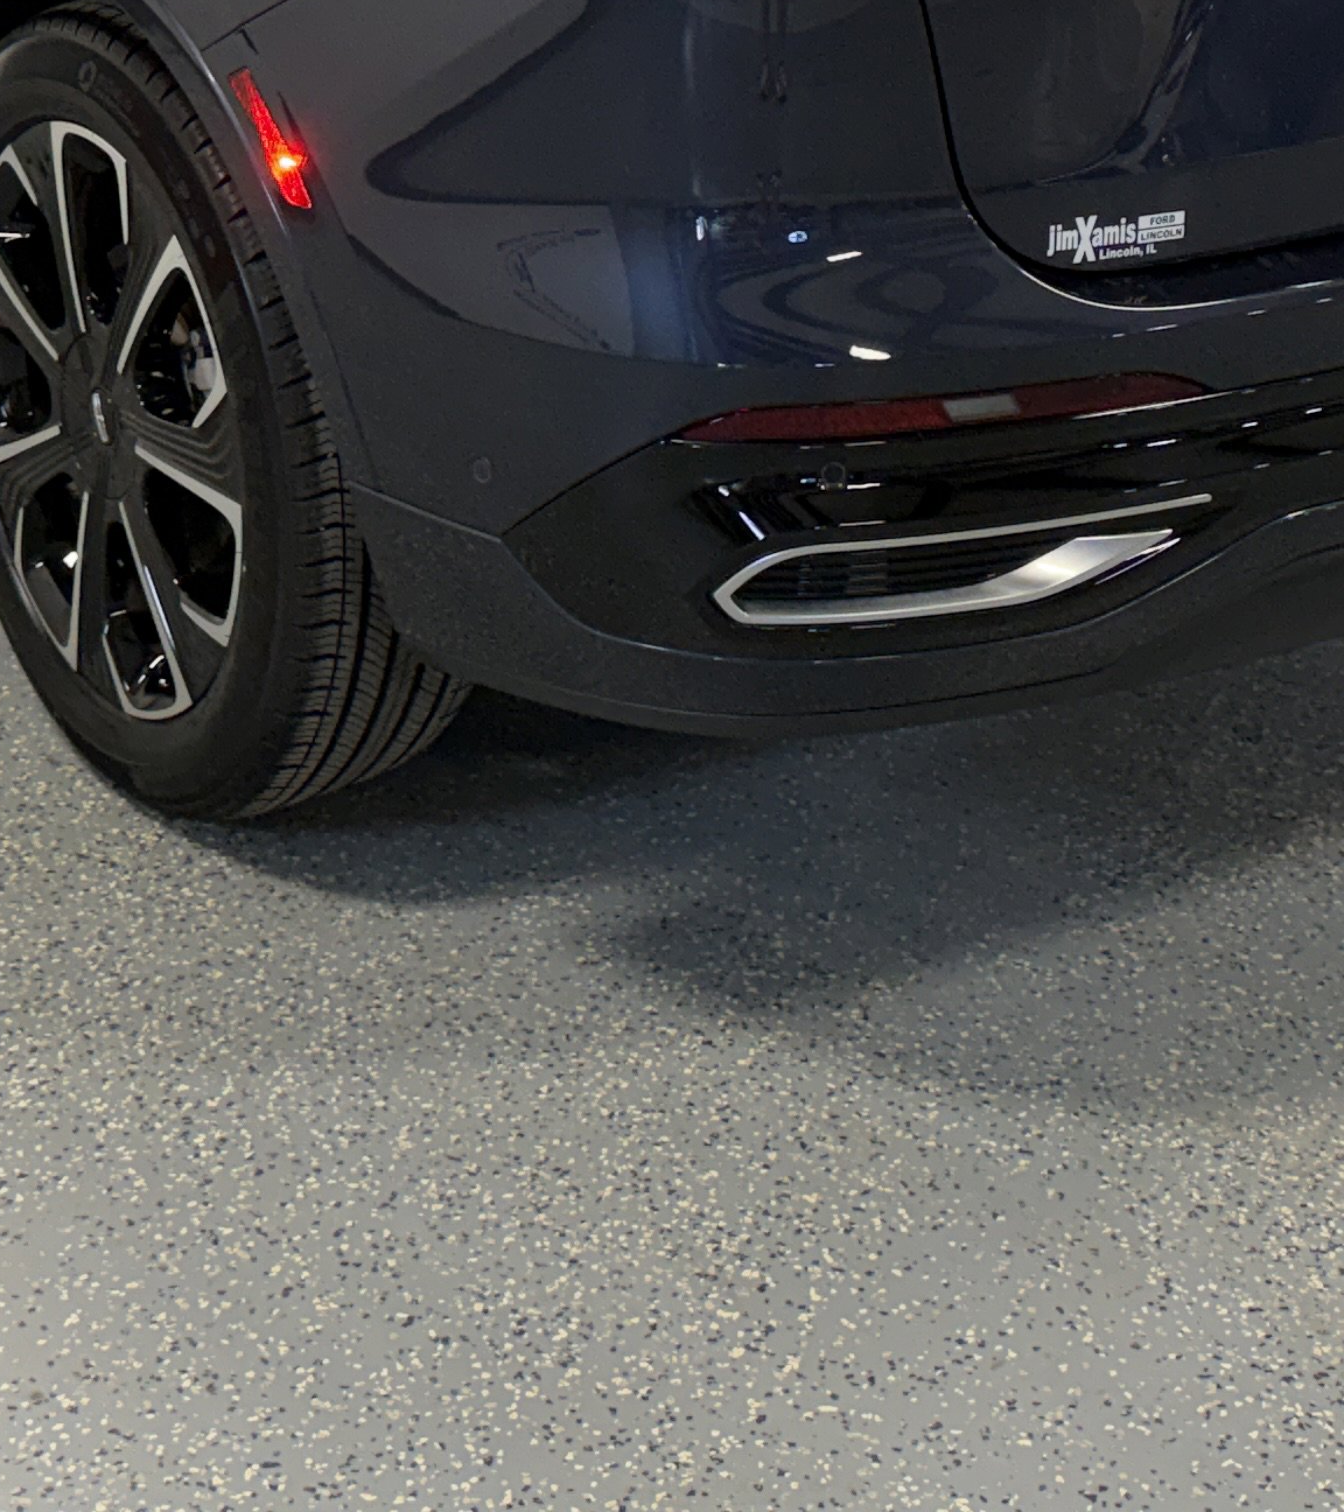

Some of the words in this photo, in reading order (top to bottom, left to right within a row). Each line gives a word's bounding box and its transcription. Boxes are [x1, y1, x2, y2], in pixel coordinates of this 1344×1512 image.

[1150, 214, 1175, 226] FORD
[1140, 228, 1182, 241] LINCOLN
[1099, 245, 1144, 260] Lincoln,
[1146, 243, 1157, 254] IL
